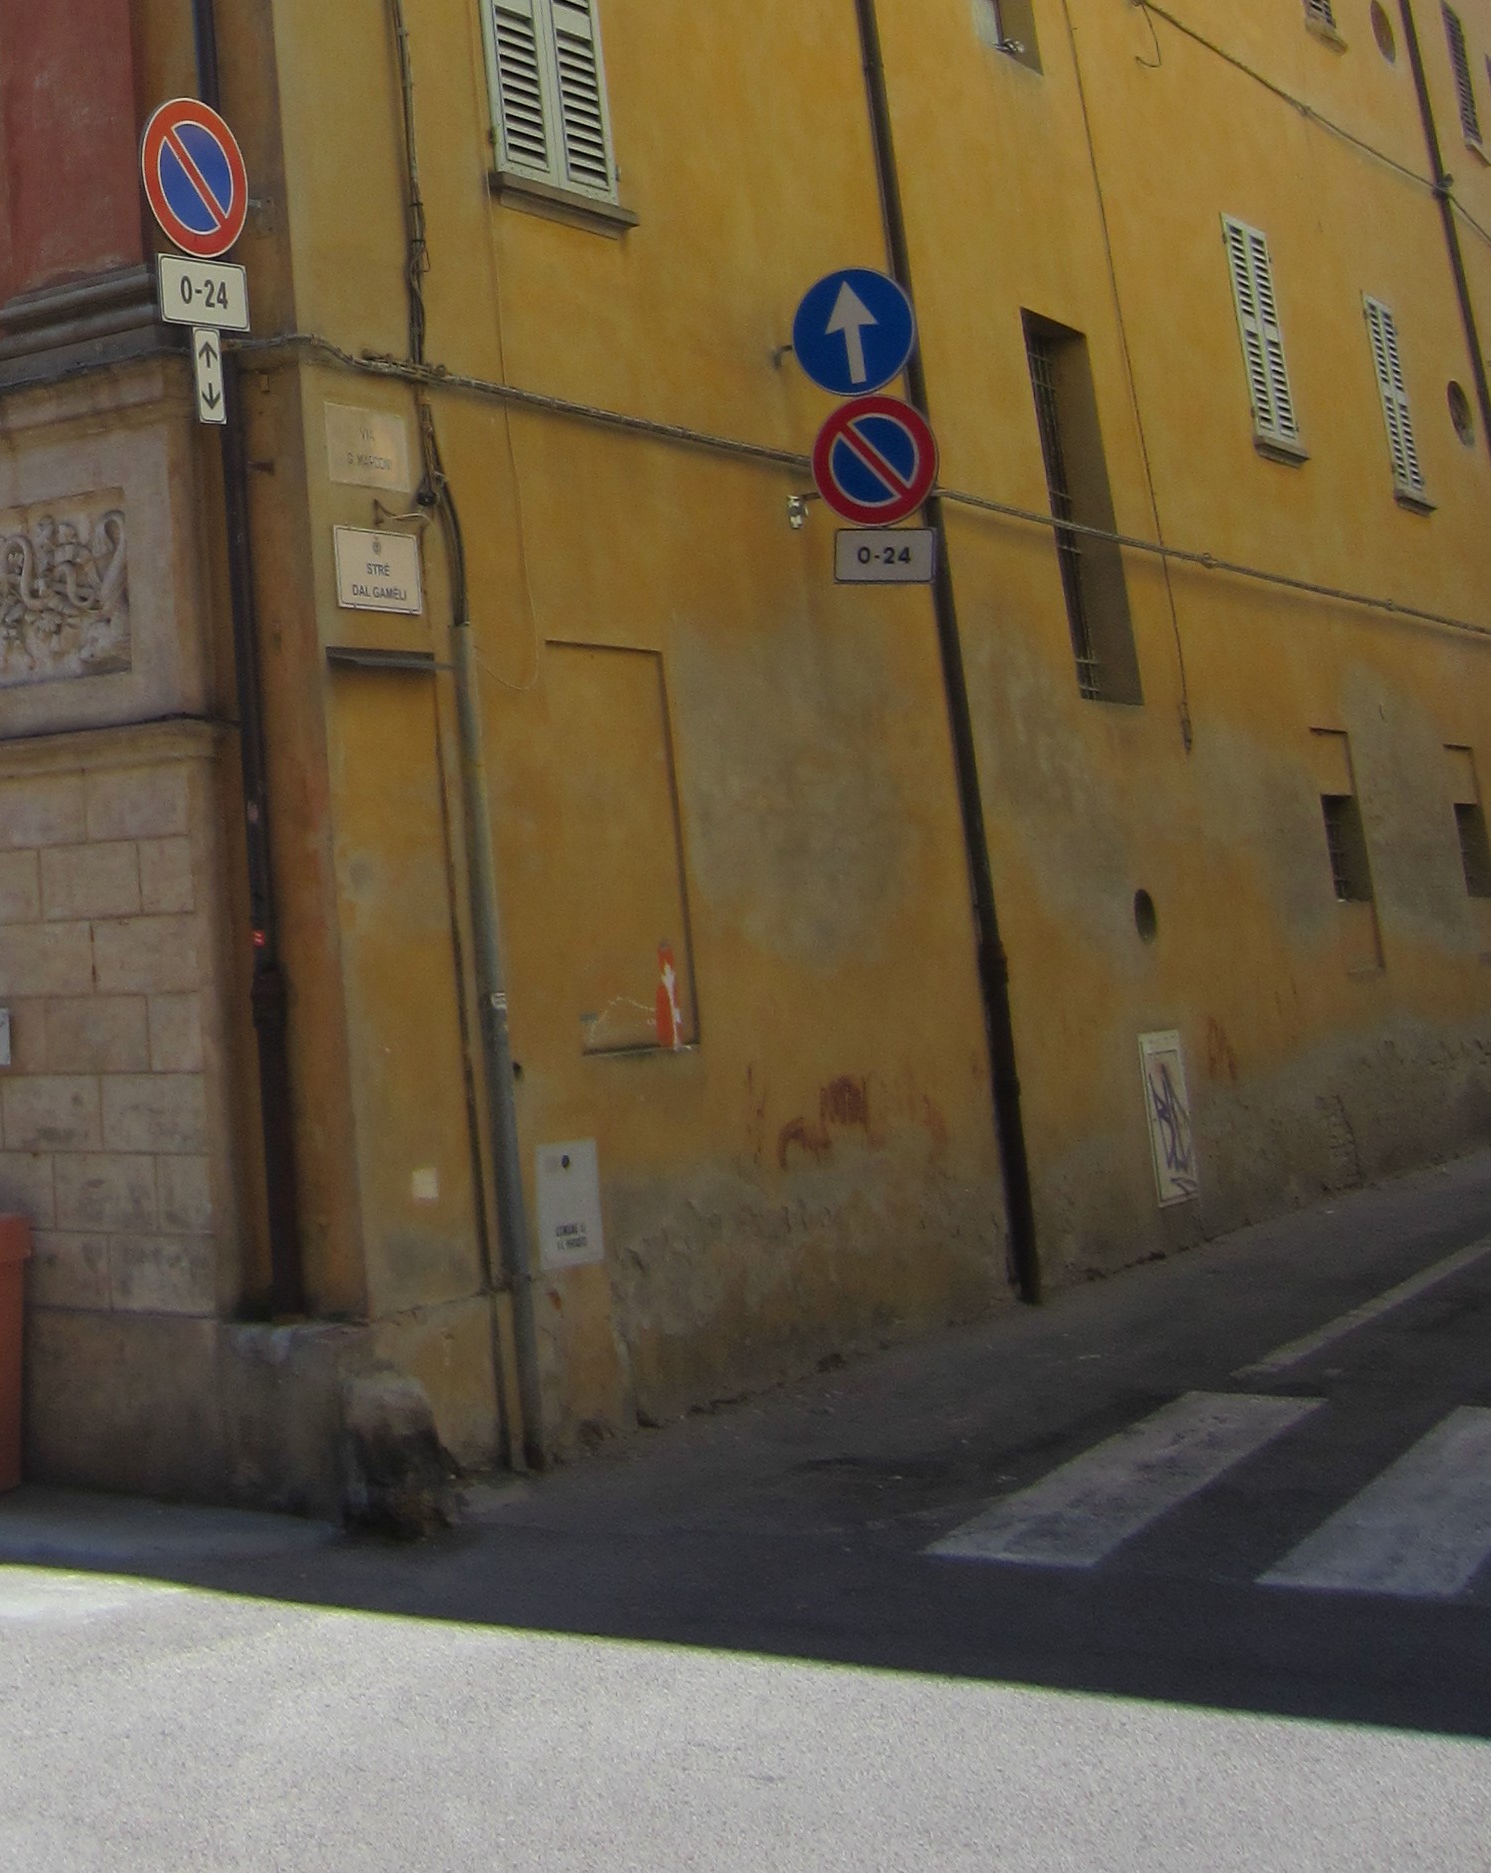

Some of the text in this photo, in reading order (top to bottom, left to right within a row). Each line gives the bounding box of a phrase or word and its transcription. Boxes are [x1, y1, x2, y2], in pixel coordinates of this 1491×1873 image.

[180, 274, 229, 310] 0-24
[359, 427, 375, 442] VIA
[857, 546, 912, 565] 0-24
[352, 583, 371, 598] DAL
